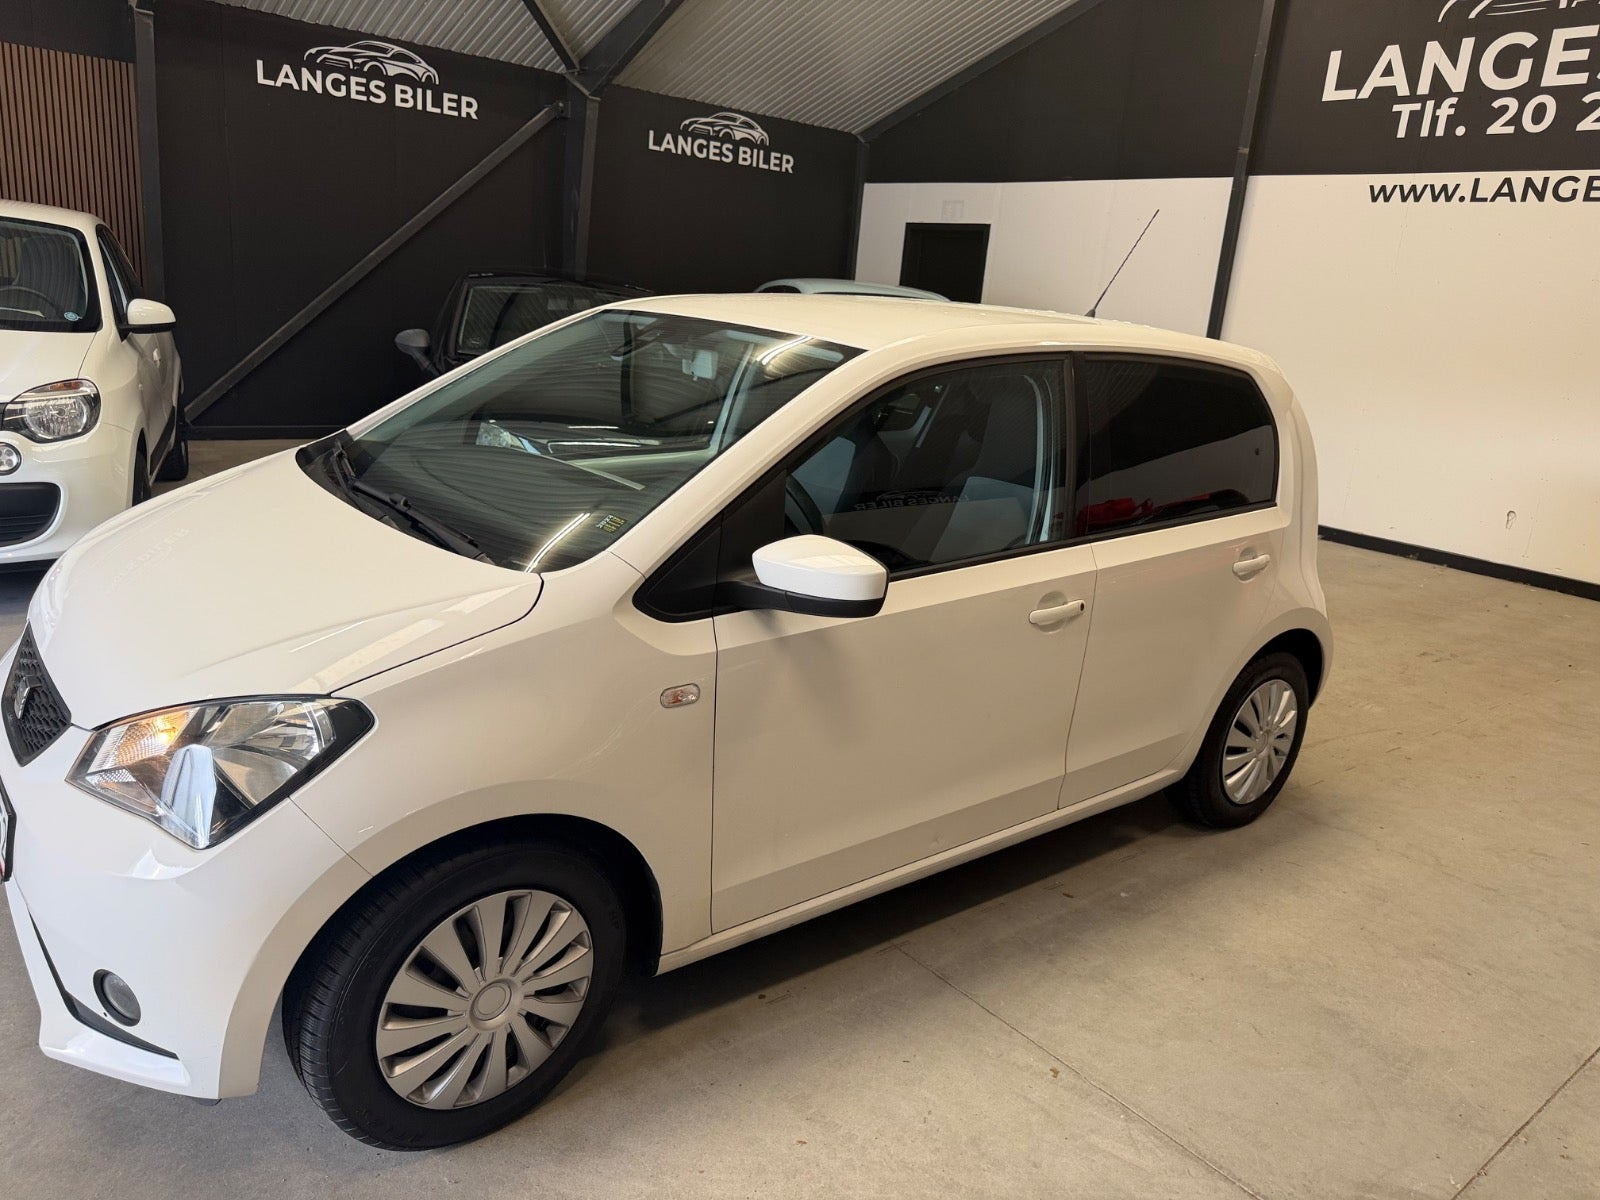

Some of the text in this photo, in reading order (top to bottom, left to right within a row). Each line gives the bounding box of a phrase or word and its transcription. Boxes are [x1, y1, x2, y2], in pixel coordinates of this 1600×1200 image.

[256, 59, 479, 120] LANGES BILER
[1322, 25, 1600, 101] LANGE
[1391, 97, 1466, 138] Tlf.
[1486, 94, 1556, 134] 20
[648, 129, 795, 174] LANGES BILER
